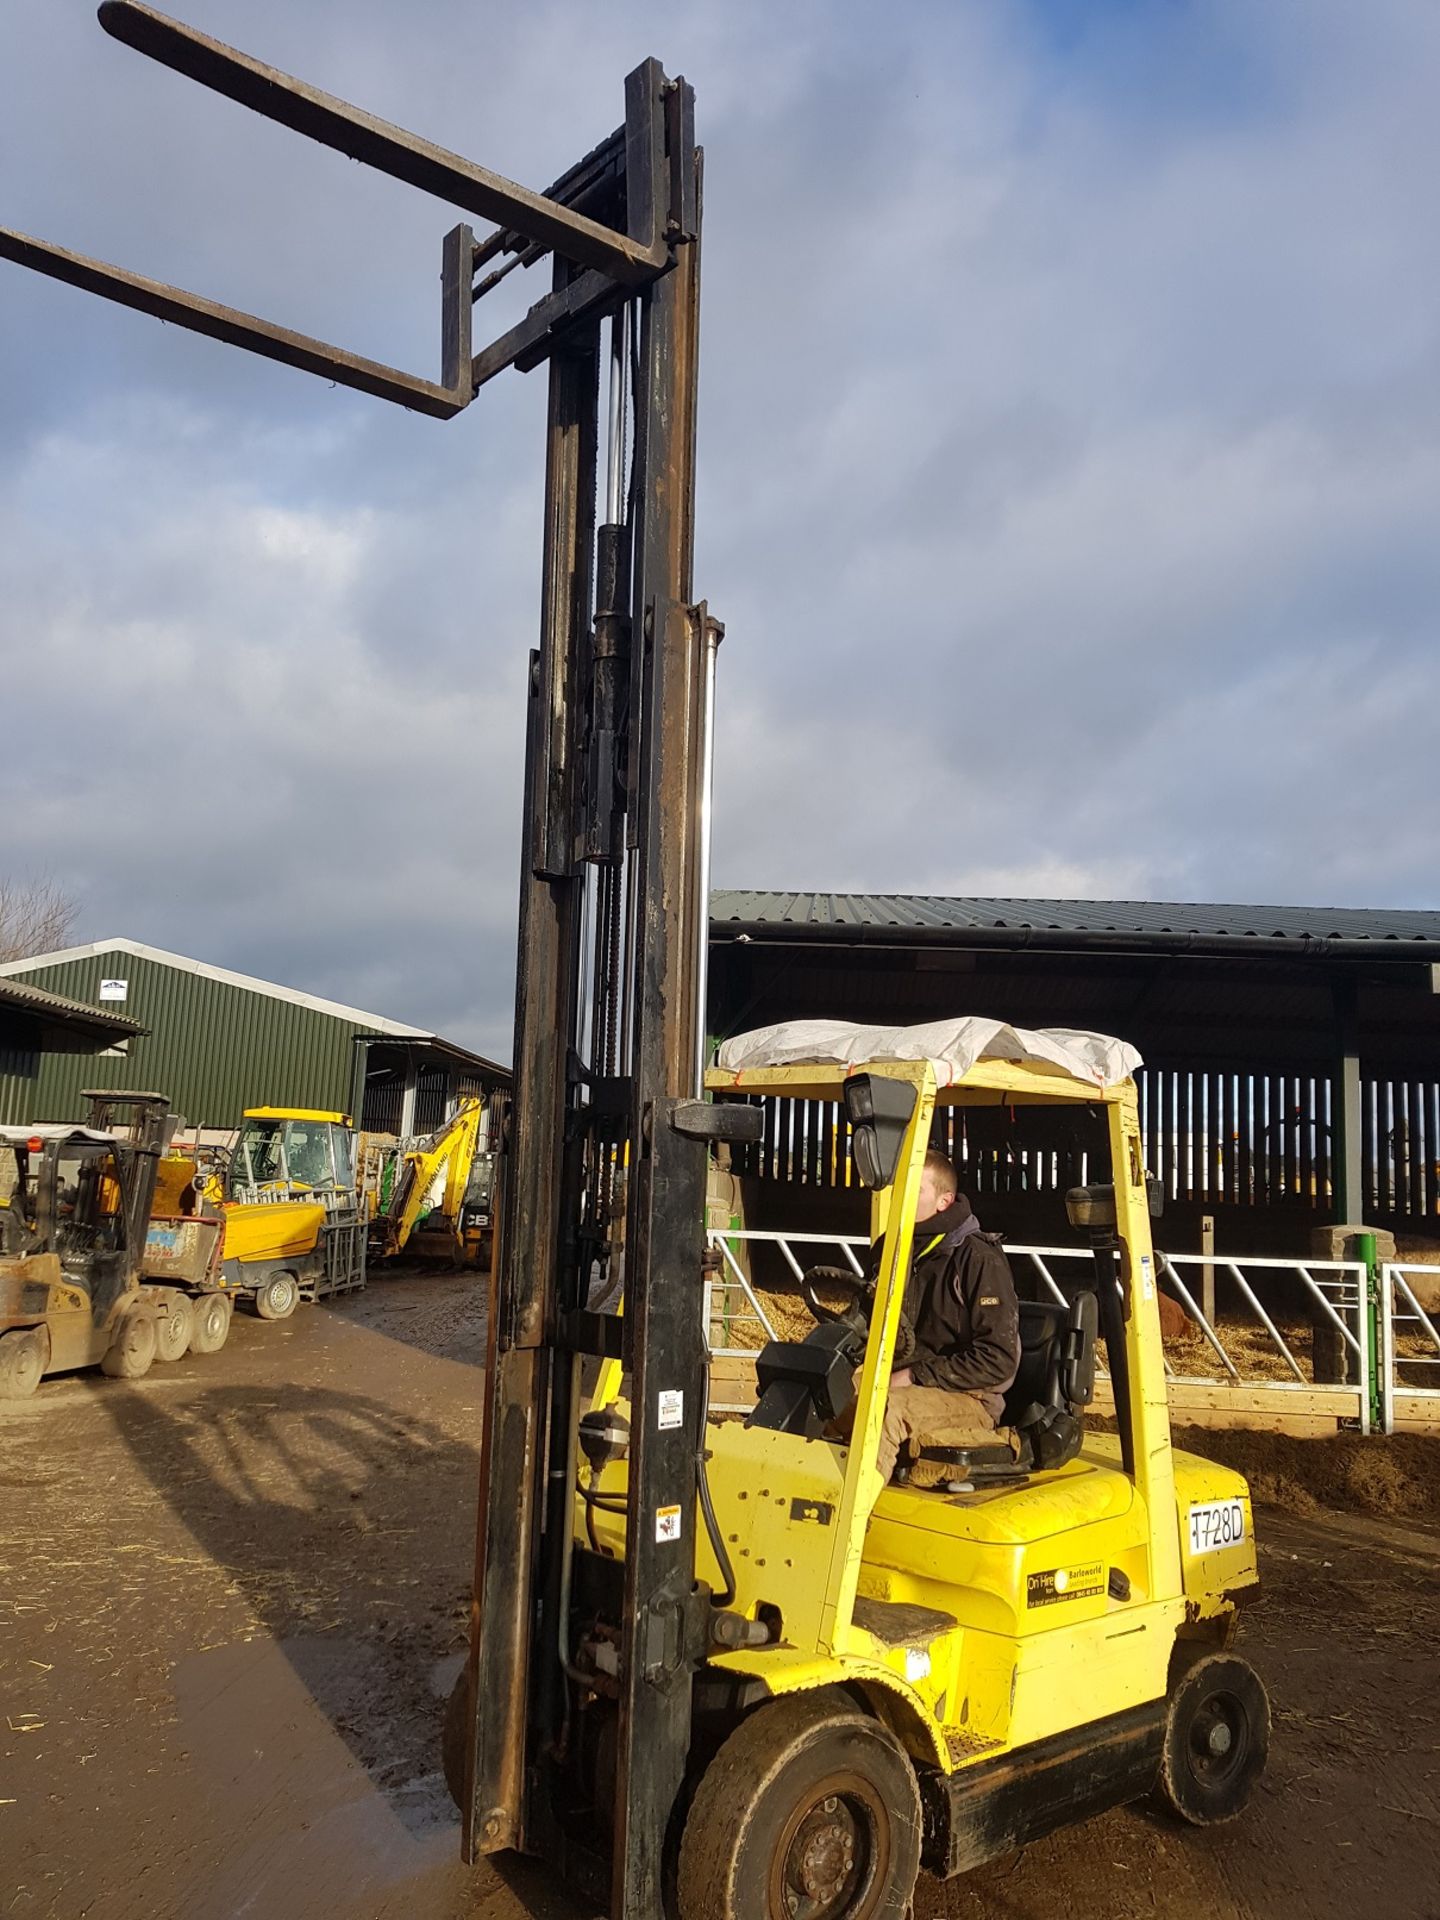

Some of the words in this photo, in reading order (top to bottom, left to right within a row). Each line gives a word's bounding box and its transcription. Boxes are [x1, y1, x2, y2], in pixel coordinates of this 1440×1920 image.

[428, 1153, 448, 1187] HOLLAND
[1192, 1505, 1243, 1549] T728D
[1027, 1577, 1039, 1590] On
[1040, 1574, 1054, 1588] Hire
[1069, 1565, 1102, 1579] Barloworld
